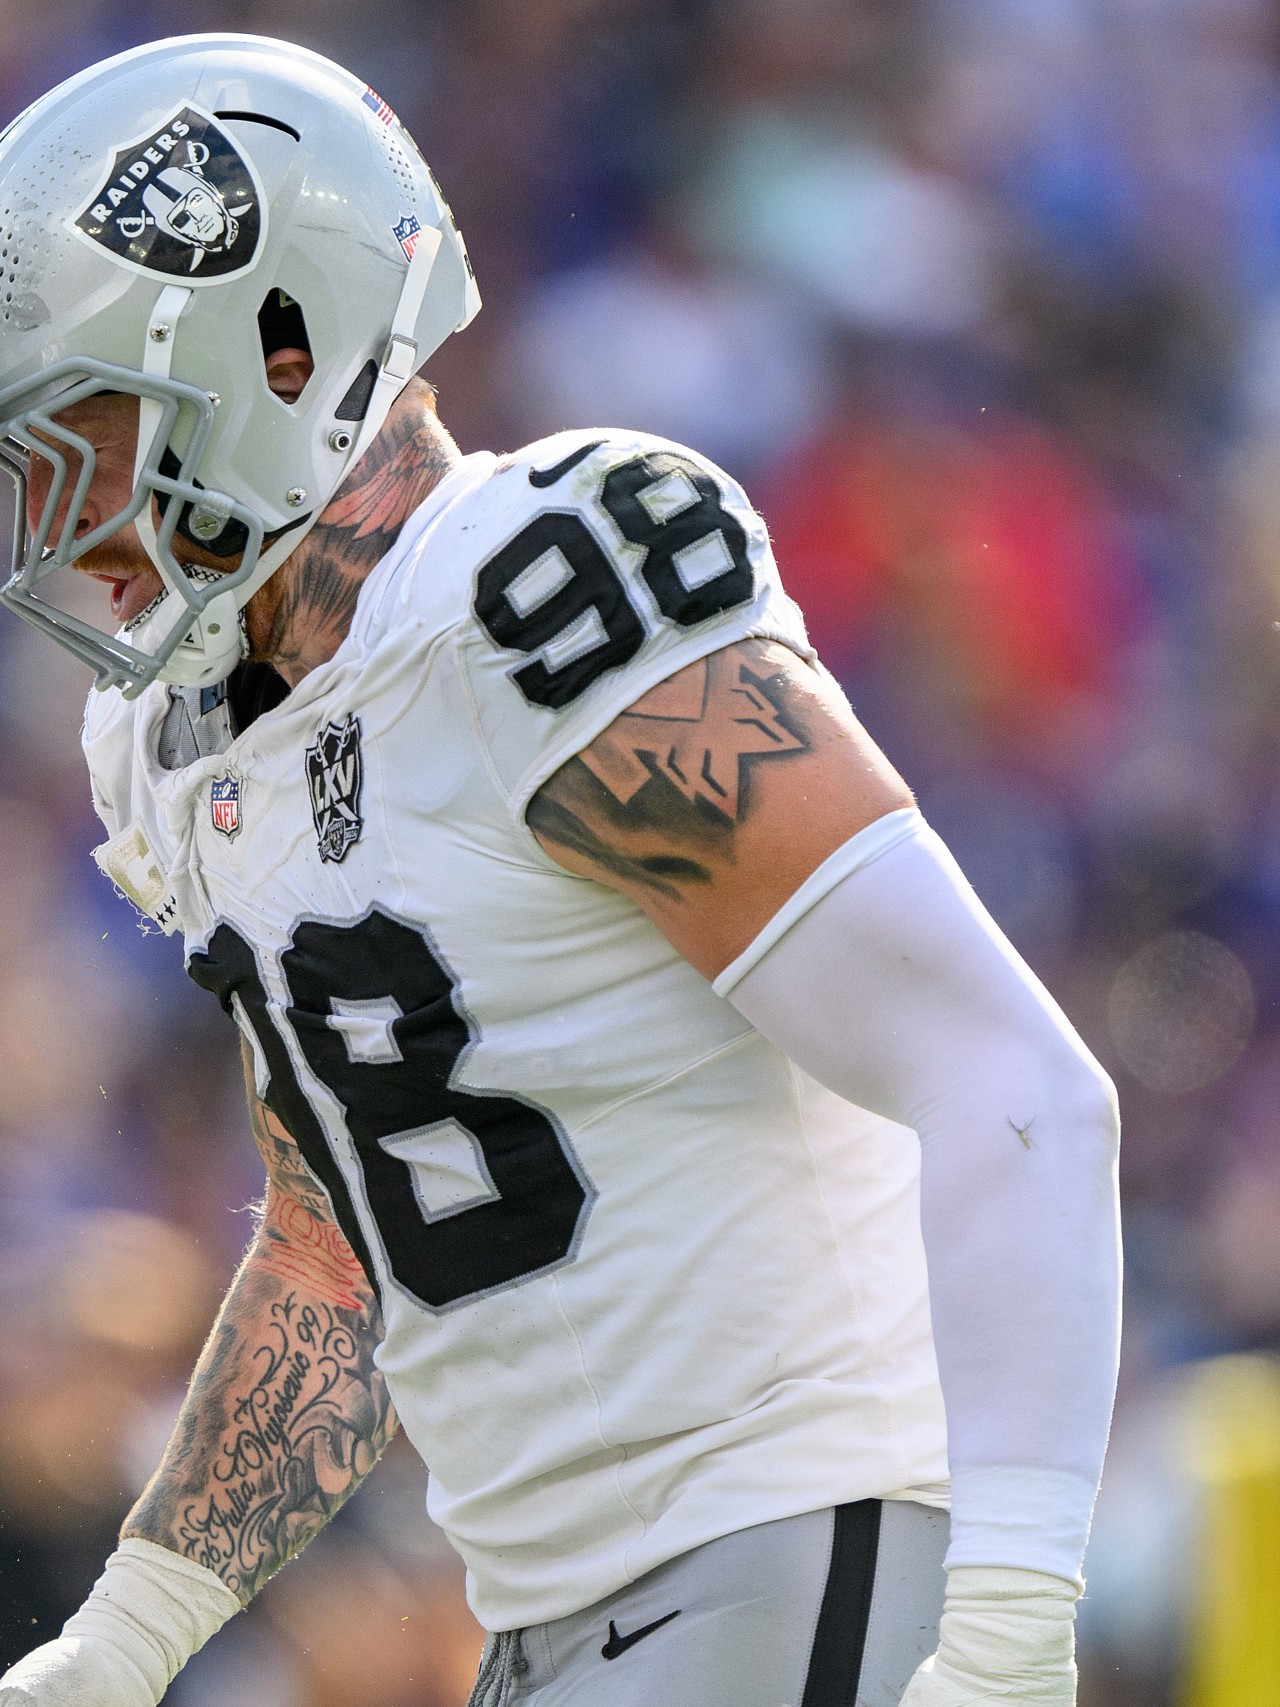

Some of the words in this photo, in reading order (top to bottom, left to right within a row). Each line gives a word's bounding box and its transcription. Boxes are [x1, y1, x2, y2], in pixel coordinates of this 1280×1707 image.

[90, 120, 190, 223] RAIDERS
[402, 232, 421, 260] NF
[471, 451, 757, 712] 98
[314, 754, 355, 815] LXV
[213, 801, 238, 830] NFL
[296, 1305, 322, 1351] 99
